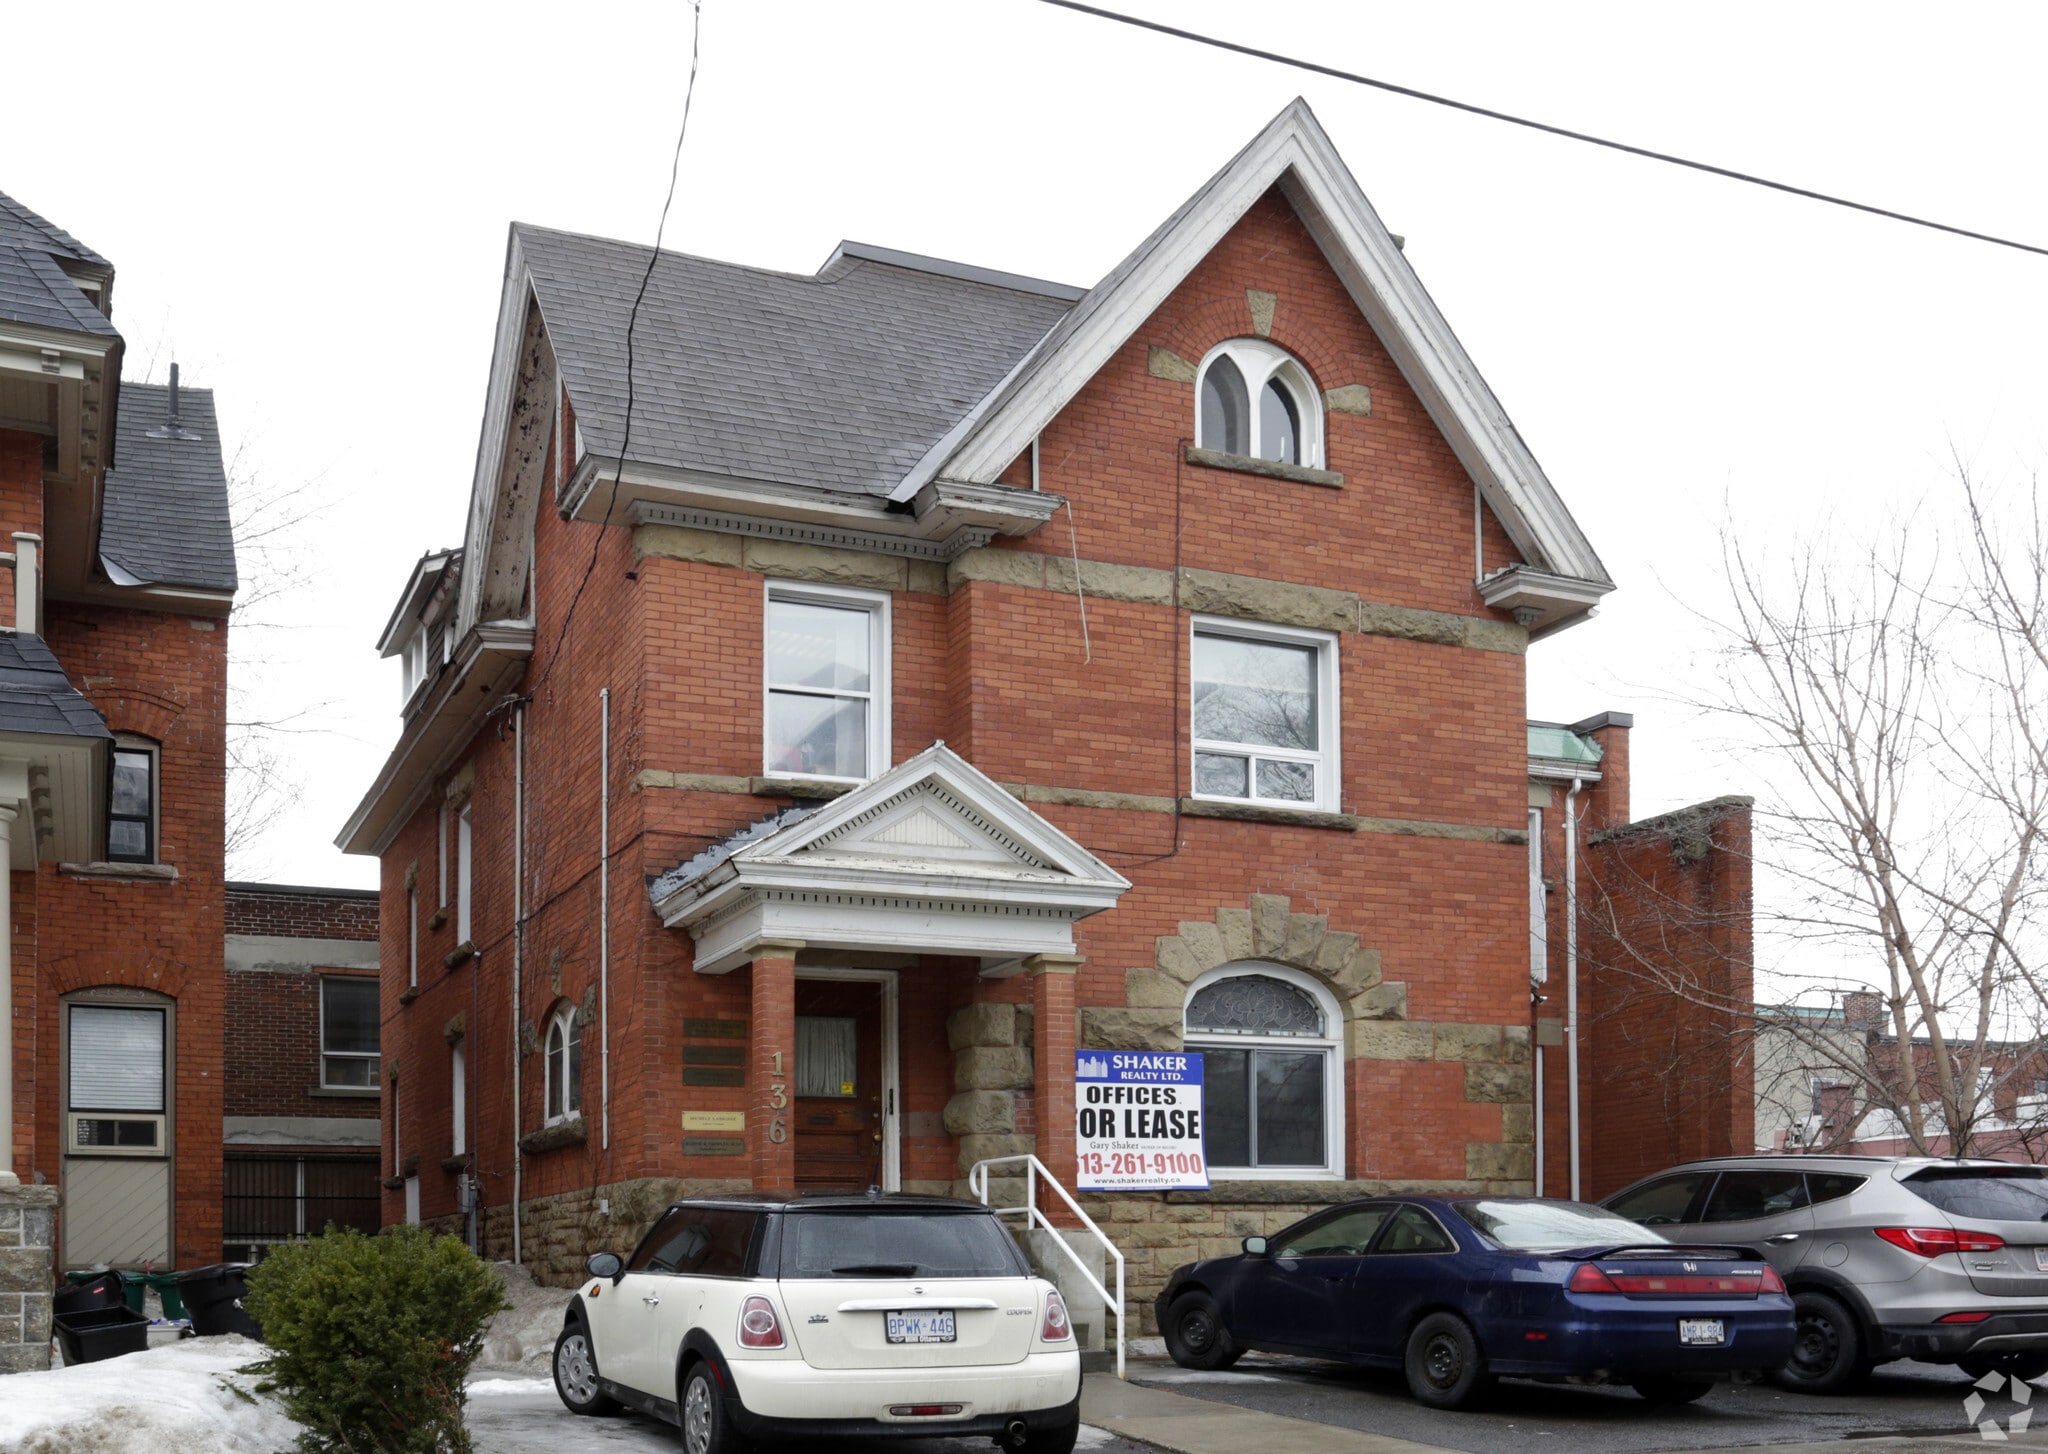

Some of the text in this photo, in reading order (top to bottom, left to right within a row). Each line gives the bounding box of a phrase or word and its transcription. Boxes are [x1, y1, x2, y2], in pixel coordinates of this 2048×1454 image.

[1113, 1055, 1187, 1070] SHAKER
[1121, 1071, 1184, 1081] REALTY LTD.
[1086, 1086, 1176, 1105] OFFICES
[1076, 1107, 1200, 1139] OR LEASE
[1089, 1141, 1109, 1151] Gary
[1111, 1141, 1139, 1150] Shaker
[889, 1317, 954, 1335] BPWK 446
